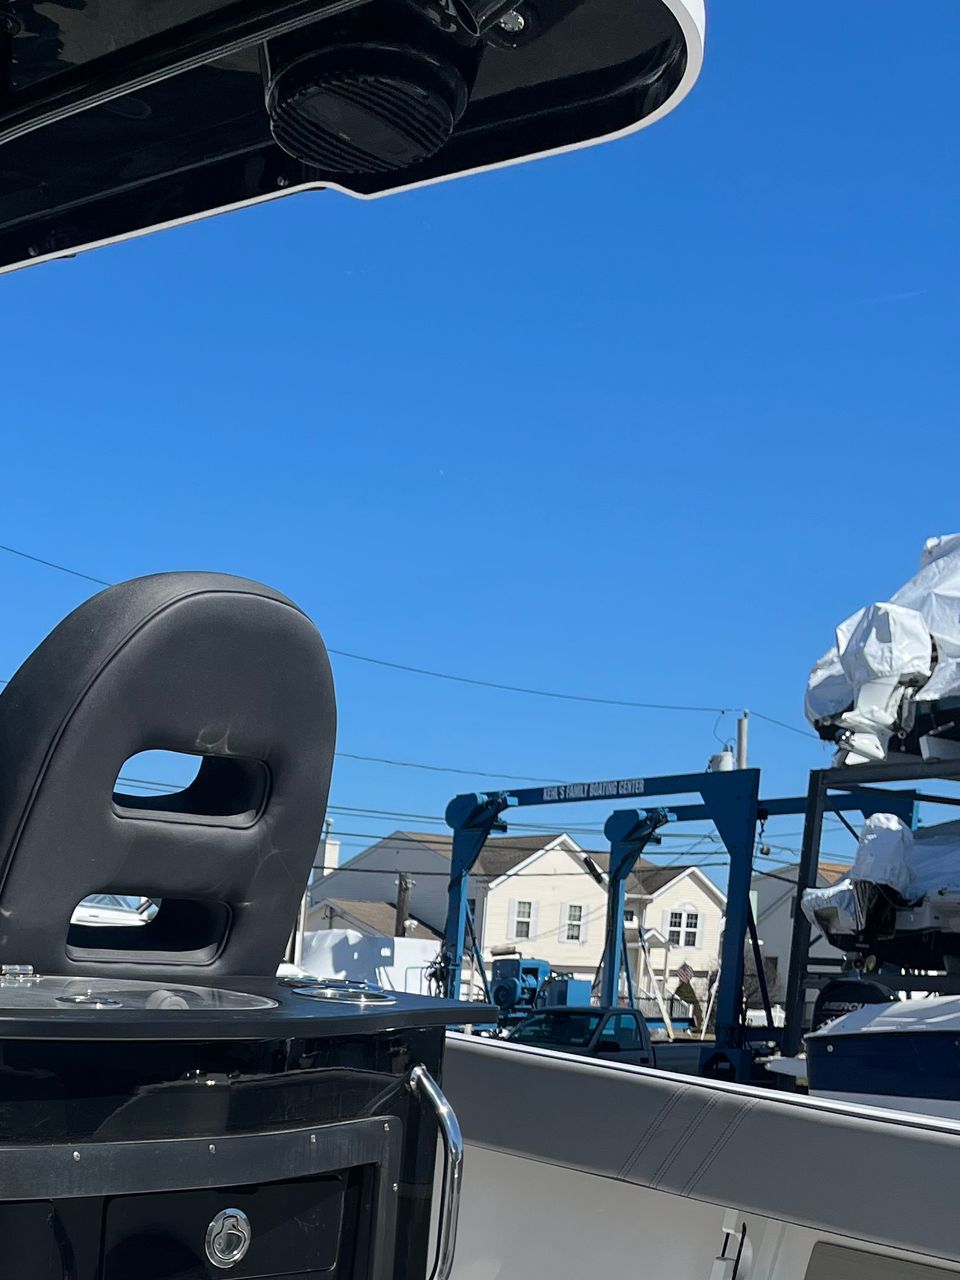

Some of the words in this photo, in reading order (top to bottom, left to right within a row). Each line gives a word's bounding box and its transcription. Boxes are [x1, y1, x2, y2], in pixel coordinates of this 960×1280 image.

[566, 783, 589, 799] FAMILY
[589, 781, 618, 797] BOATING
[619, 779, 645, 794] CENTER
